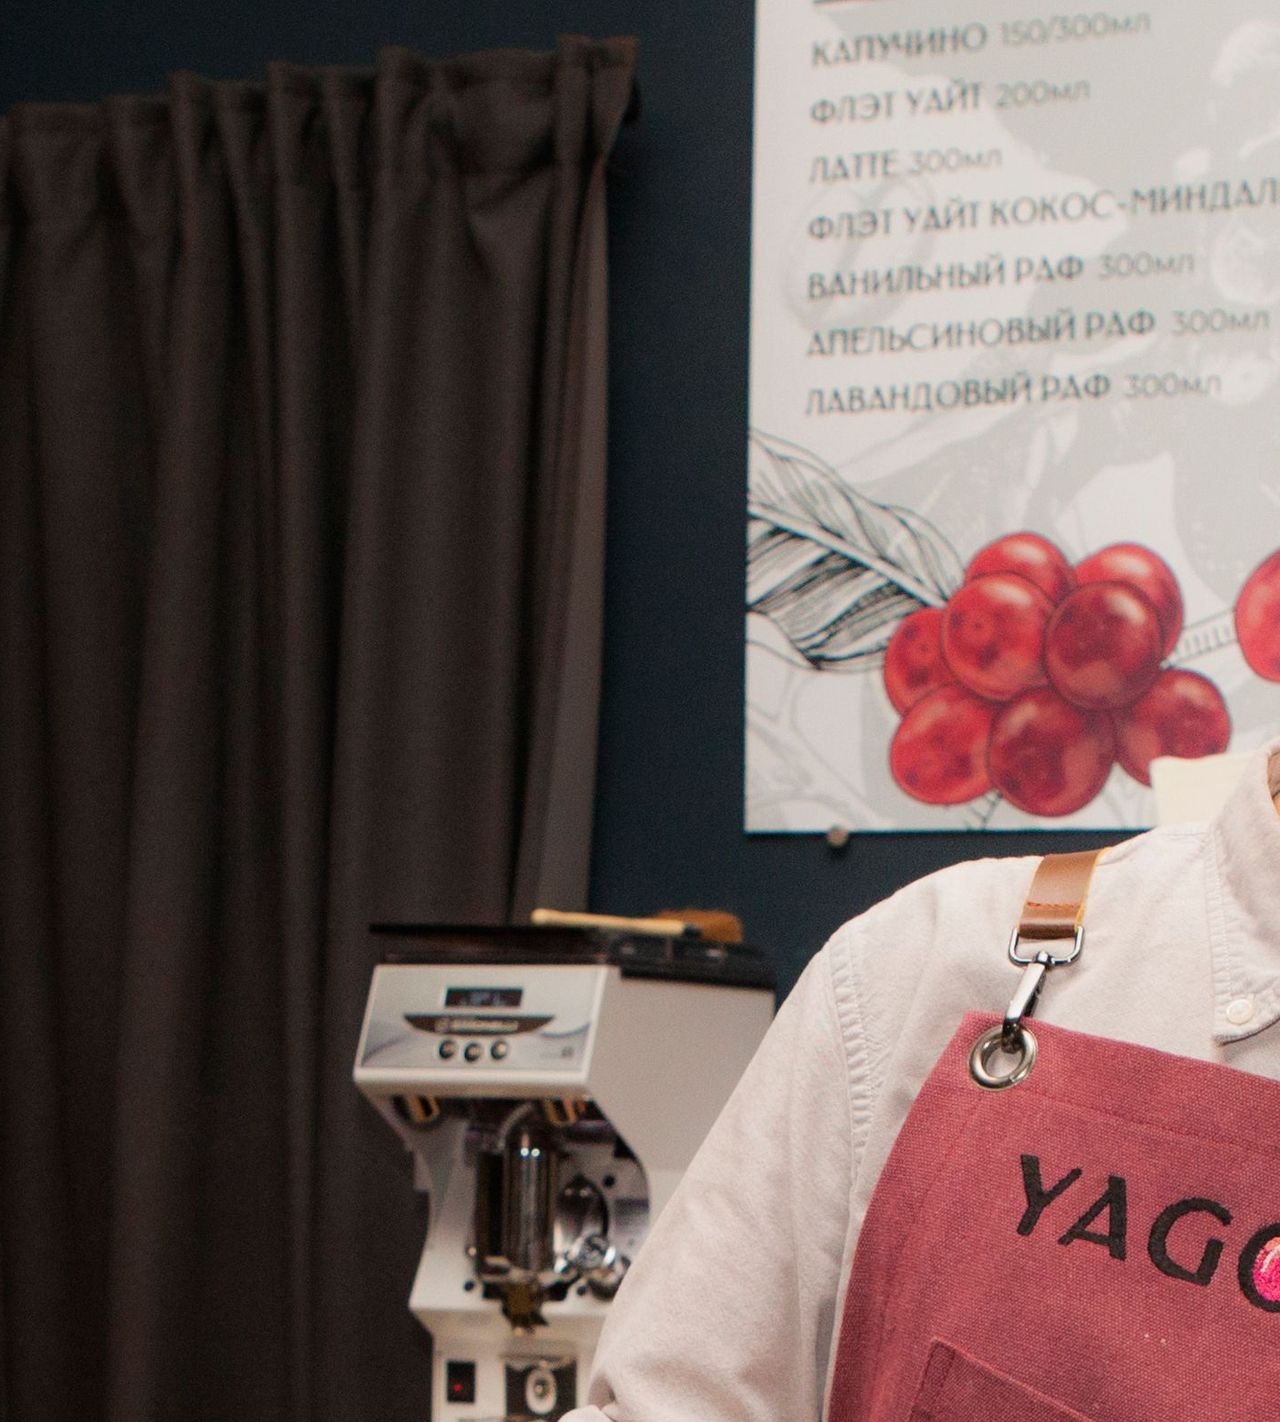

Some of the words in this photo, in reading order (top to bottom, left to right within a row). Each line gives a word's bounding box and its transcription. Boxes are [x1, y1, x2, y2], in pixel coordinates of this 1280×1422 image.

[811, 22, 988, 68] КАПУЧИНО
[810, 89, 897, 125] ФЛЭТ
[906, 77, 982, 115] УАЙТ
[994, 79, 1091, 109] 200мл
[809, 149, 898, 183] ЛАТТЕ
[907, 147, 1003, 174] 300мл
[807, 208, 893, 240] ФЛЭТ
[902, 197, 981, 233] УАЙТ
[808, 253, 1006, 300] ВАНИЛЬНЫЙ
[1014, 255, 1084, 286] РАФ
[1098, 251, 1197, 281] 300мл
[807, 308, 1077, 356] АПЕЛЬСИНОВЫЙ
[1085, 310, 1157, 340] РАФ
[1170, 308, 1271, 336] 300мл
[805, 370, 1032, 417] ЛАВАНДОВЫЙ
[1041, 373, 1112, 401] РАФ
[1124, 371, 1223, 399] 300мл
